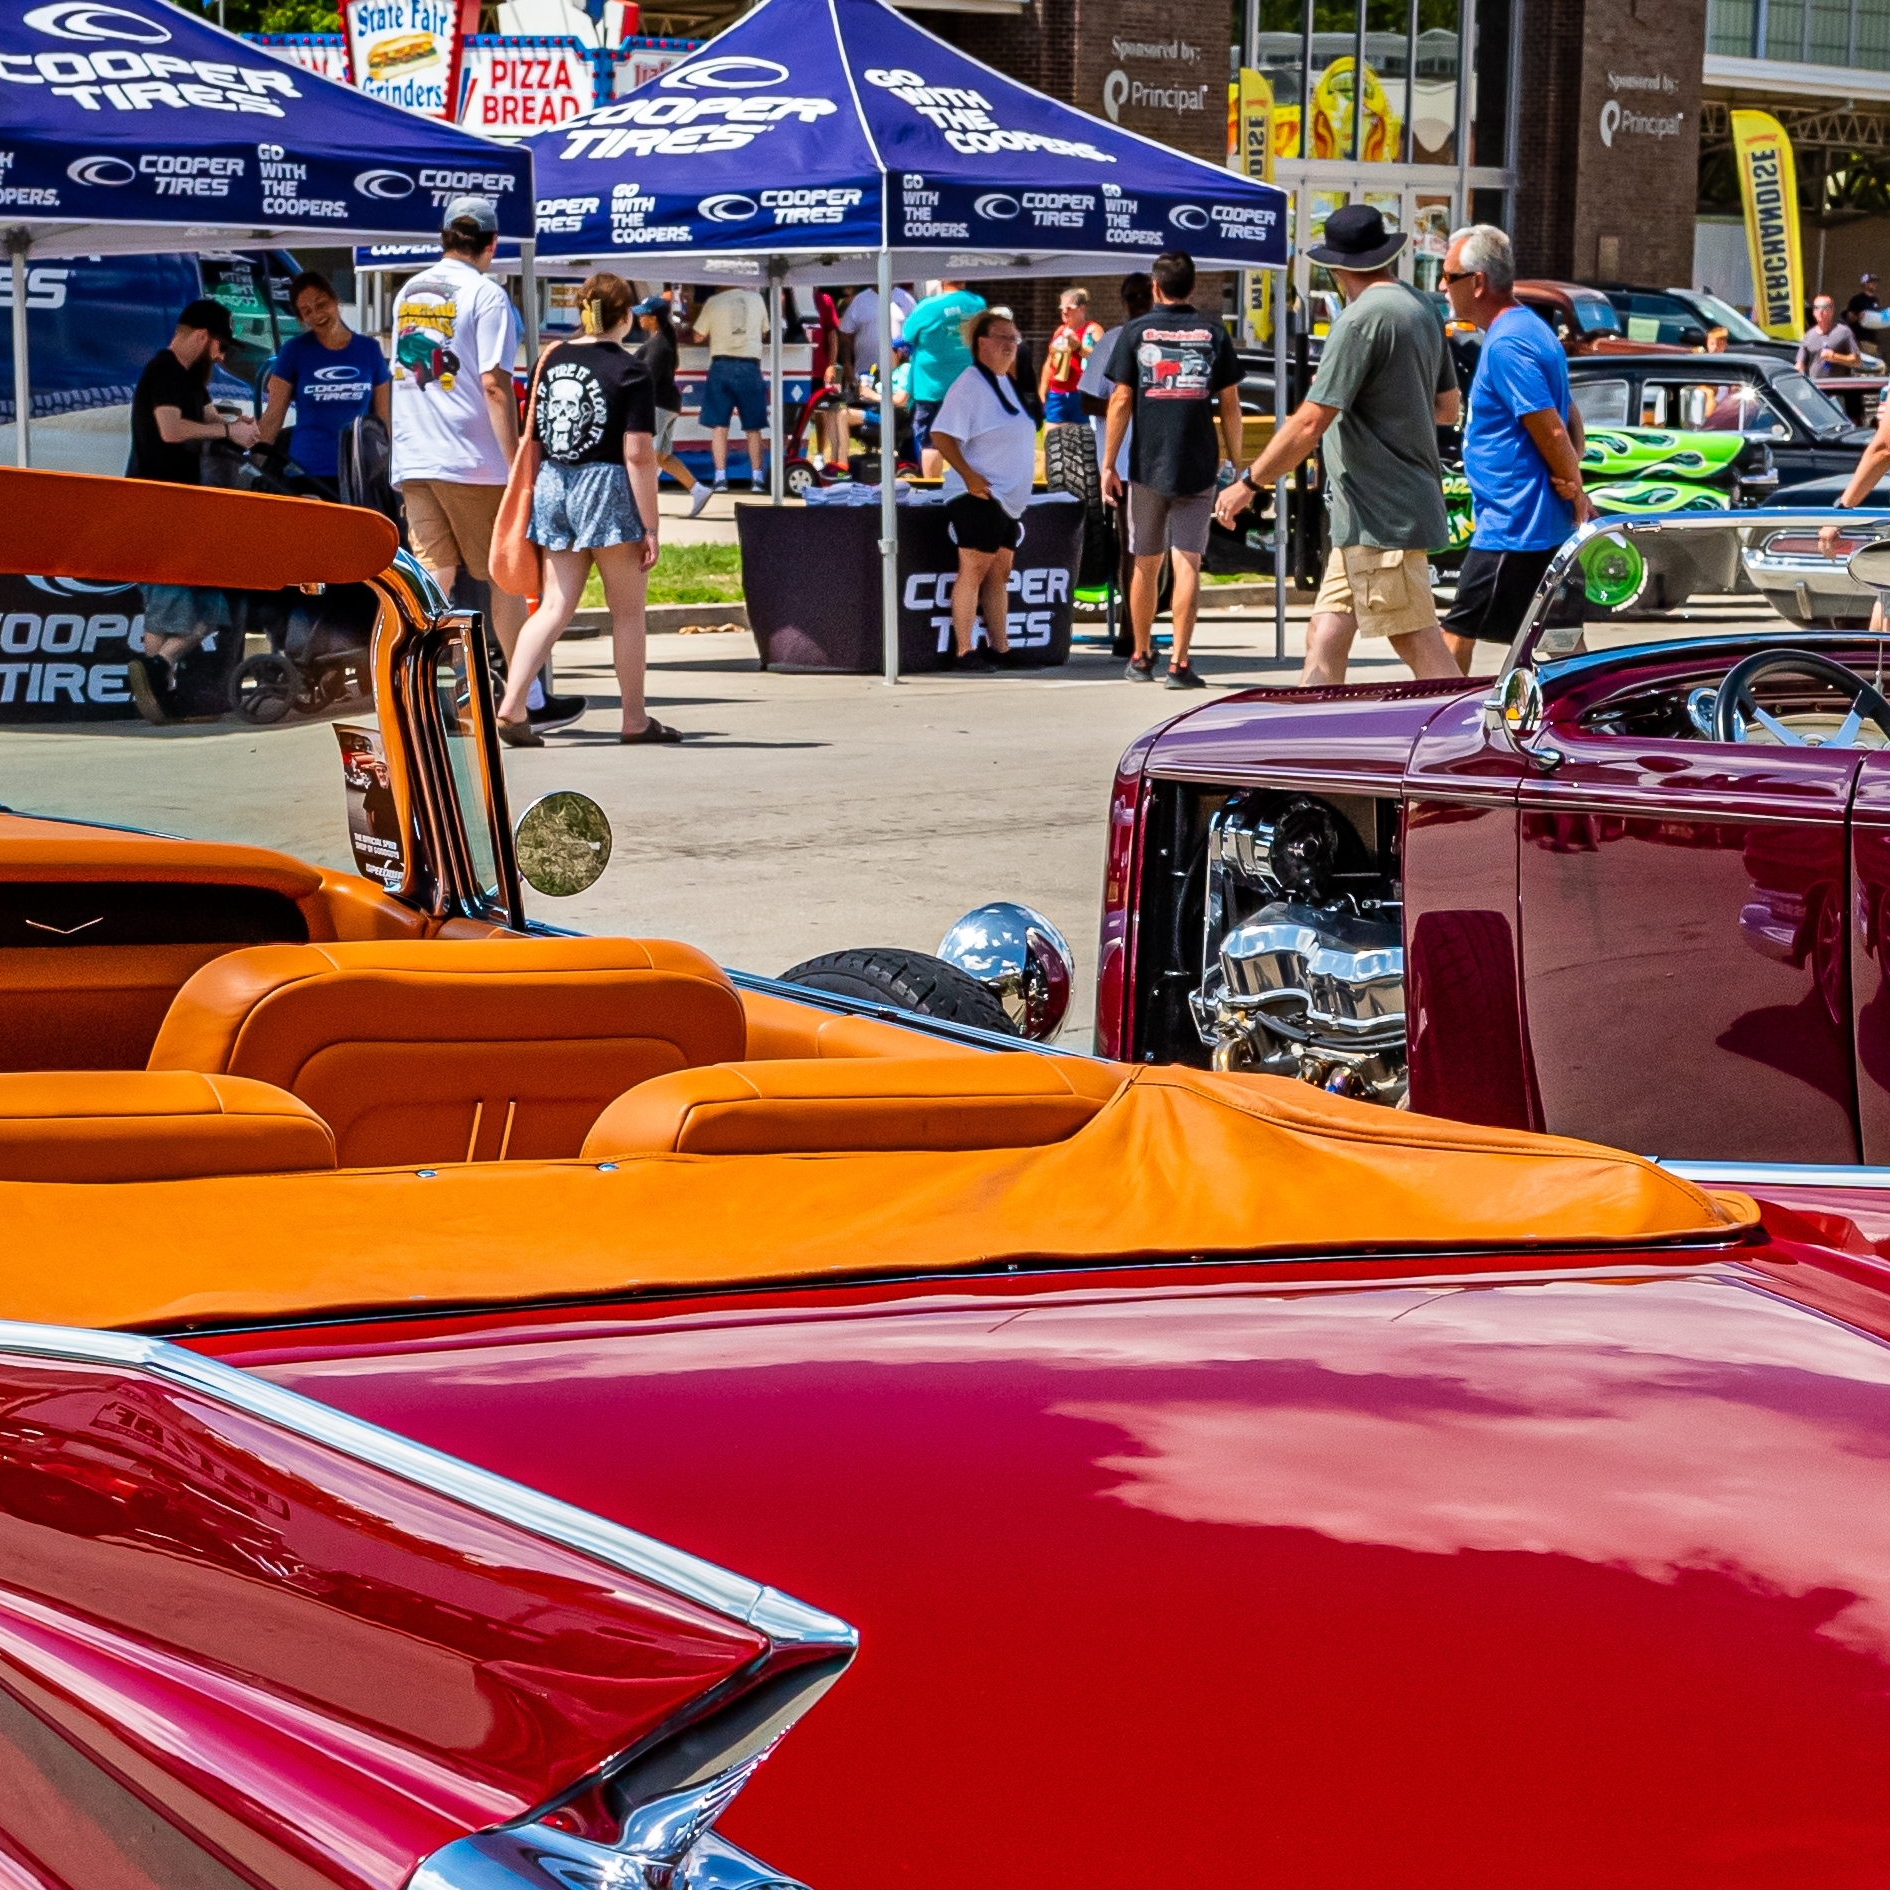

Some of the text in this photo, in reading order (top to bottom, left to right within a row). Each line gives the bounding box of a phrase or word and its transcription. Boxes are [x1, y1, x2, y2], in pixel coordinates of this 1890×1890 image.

[357, 0, 447, 37] State Fair
[491, 60, 572, 90] PIZZA
[864, 69, 926, 88] GO
[51, 82, 286, 118] TIRES
[362, 78, 442, 107] Grinders
[889, 87, 993, 110] WITH
[1132, 81, 1204, 115] Principal
[483, 95, 581, 125] BREAD
[547, 97, 838, 132] COOPER
[916, 106, 999, 131] THE
[560, 124, 768, 159] TIRES
[258, 144, 285, 161] GO
[139, 155, 244, 176] COOPER
[261, 162, 306, 181] WITH
[155, 177, 230, 196] TIRES
[262, 180, 297, 197] THE
[419, 169, 515, 191] COOPER
[903, 174, 924, 190] GO
[613, 183, 640, 198] GO
[760, 189, 862, 207] COOPER
[903, 190, 939, 206] WITH
[1102, 183, 1122, 197] GO
[262, 198, 348, 218] COOPERS.
[611, 197, 655, 213] WITH
[1022, 192, 1095, 210] COOPER
[1105, 198, 1138, 214] WITH
[612, 213, 644, 227] THE
[773, 207, 847, 224] TIRES
[904, 206, 931, 221] THE
[1032, 210, 1085, 227] TIRES
[1105, 213, 1131, 229] THE
[1210, 205, 1277, 226] COOPER
[612, 226, 693, 243] COOPERS.
[1220, 224, 1267, 241] TIRES
[304, 383, 372, 394] COOPER
[313, 391, 364, 401] TIRES
